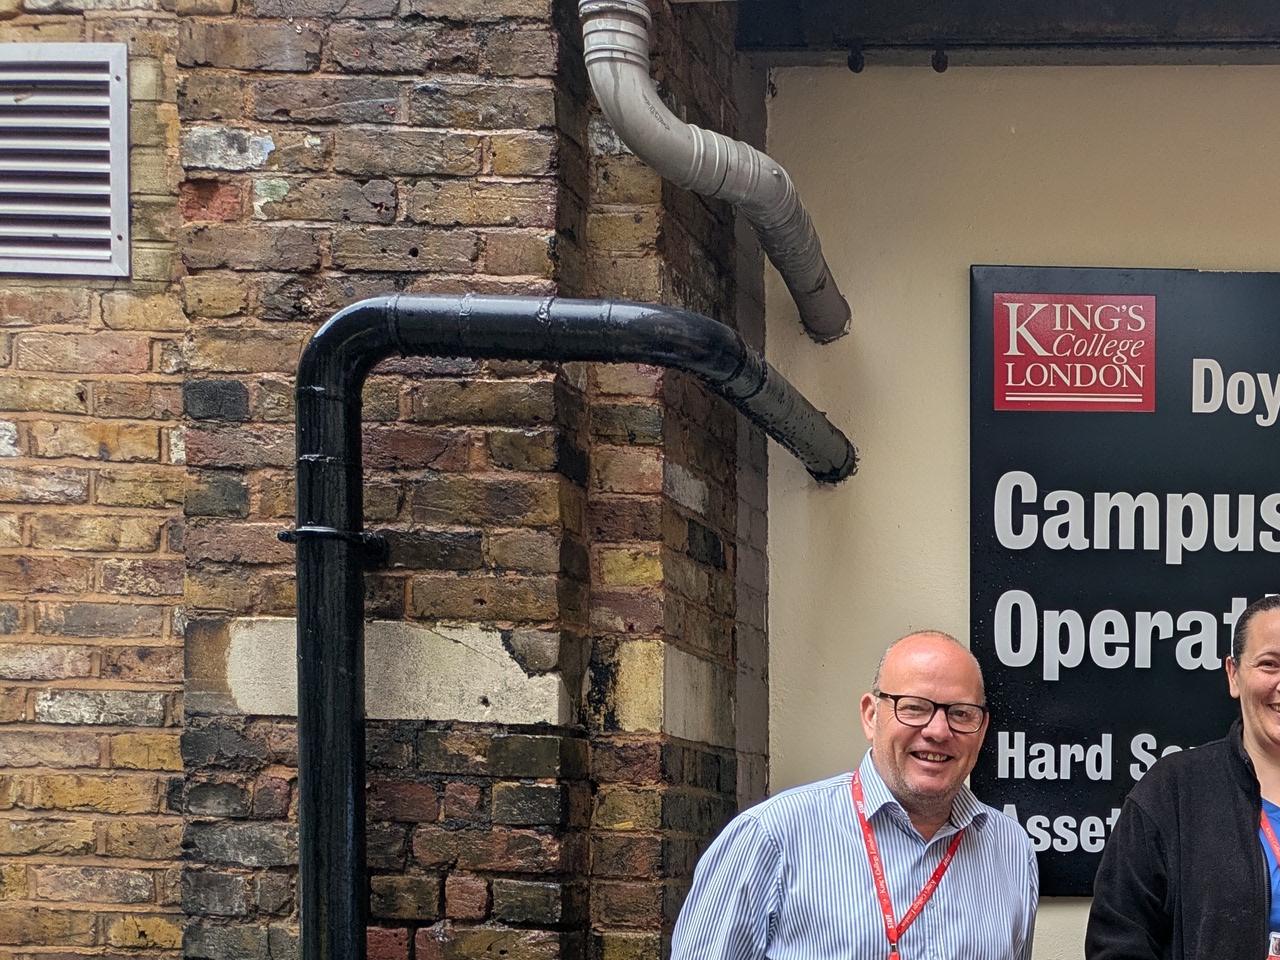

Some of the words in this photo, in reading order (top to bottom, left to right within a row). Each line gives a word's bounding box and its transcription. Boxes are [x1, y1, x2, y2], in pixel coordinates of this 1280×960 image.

[1003, 302, 1146, 356] KING'S
[1052, 332, 1145, 365] College
[1005, 362, 1146, 388] LONDON
[997, 731, 1113, 781] Hard
[873, 855, 883, 876] College
